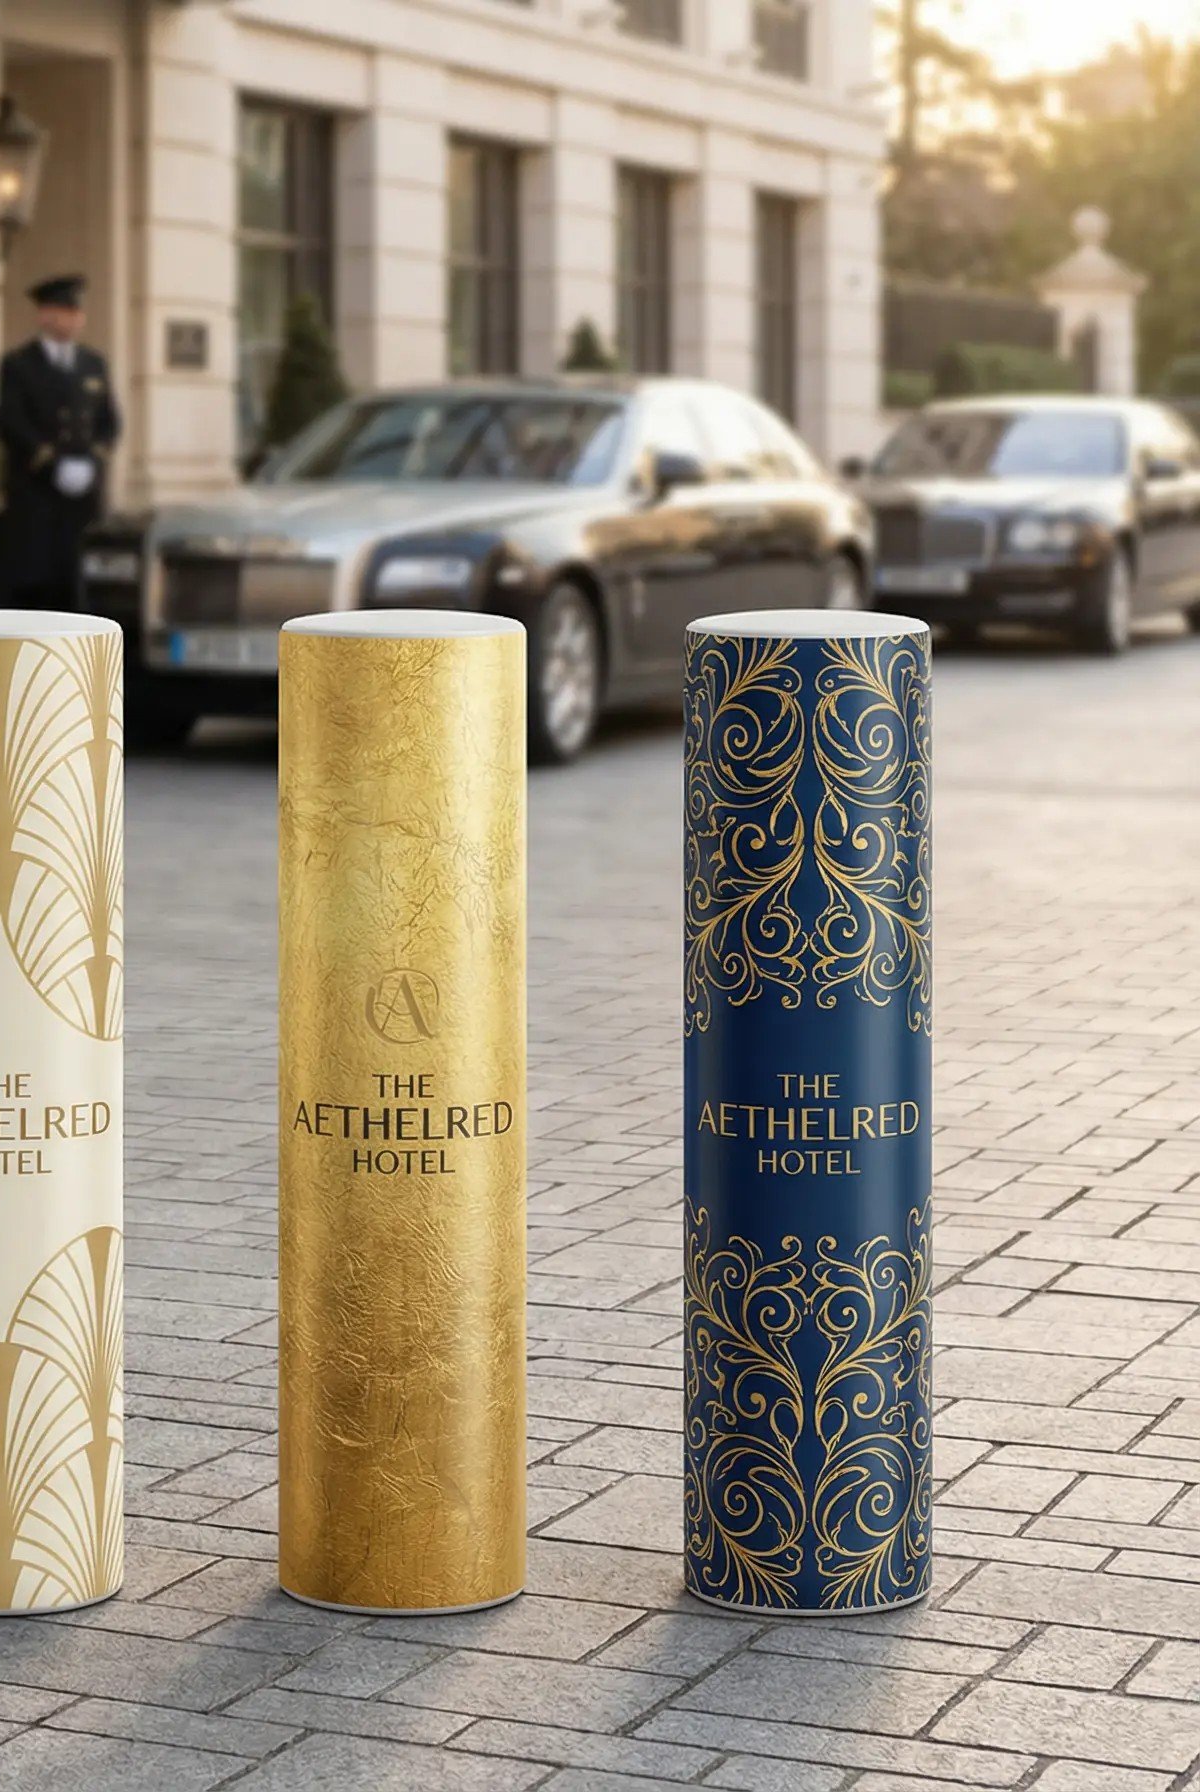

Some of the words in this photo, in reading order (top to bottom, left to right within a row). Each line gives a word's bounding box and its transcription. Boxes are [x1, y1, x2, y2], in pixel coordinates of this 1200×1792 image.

[372, 1073, 435, 1099] THE
[777, 1073, 841, 1099] THE
[292, 1100, 513, 1141] AETHELRED
[697, 1099, 920, 1141] AETHELRED
[352, 1150, 455, 1175] HOTEL
[757, 1150, 861, 1175] HOTEL
